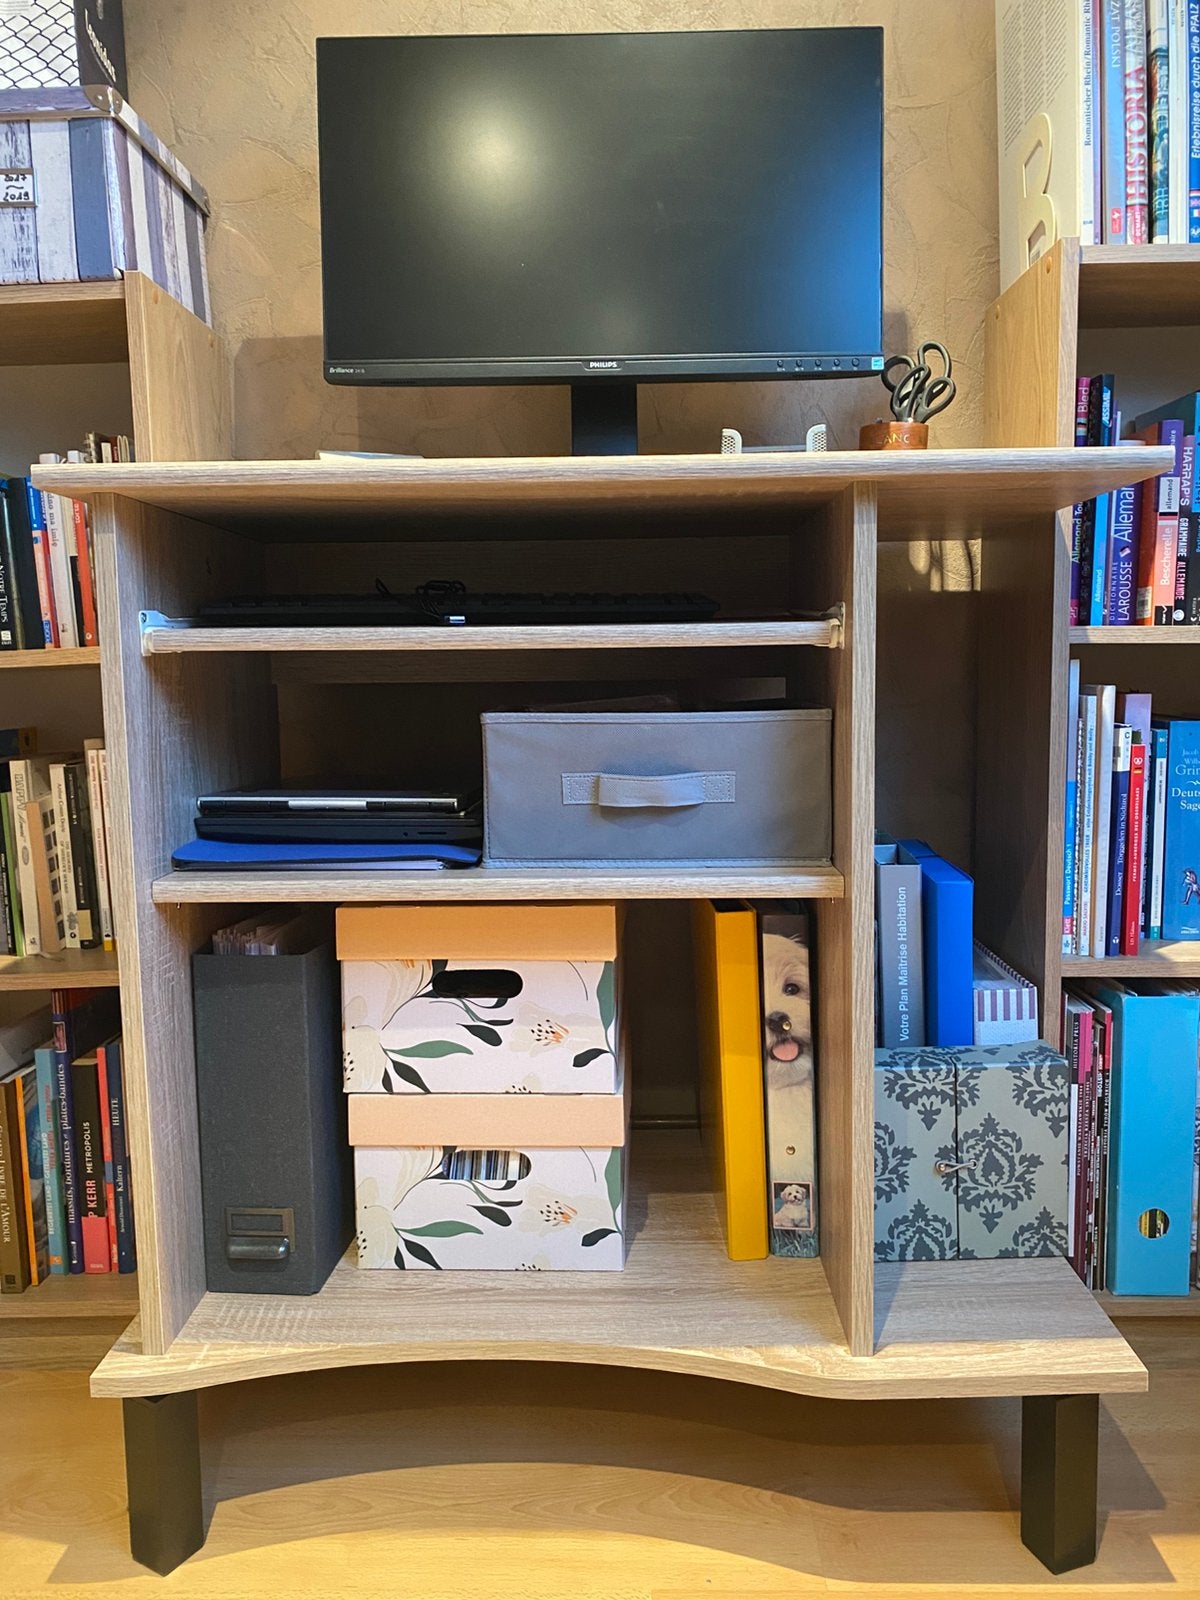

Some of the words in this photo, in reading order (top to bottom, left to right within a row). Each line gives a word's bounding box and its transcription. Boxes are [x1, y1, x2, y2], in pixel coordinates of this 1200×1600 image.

[1189, 3, 1199, 33] PFALZ
[1111, 26, 1121, 68] POLSKI
[1191, 35, 1200, 53] die
[1191, 56, 1200, 88] durch
[1083, 88, 1093, 147] Romantischer
[1125, 65, 1148, 202] HISTORIA
[1191, 89, 1200, 159] Erlebnisreise
[589, 361, 618, 369] PHILIPS
[1078, 386, 1089, 413] Bled
[1101, 389, 1112, 425] ASSIMIL
[1181, 446, 1193, 506] HARRAP'S
[1165, 478, 1174, 511] allemand
[50, 512, 56, 526] ma
[1072, 518, 1084, 564] Allemand
[1178, 517, 1190, 558] GRAMMAIRE
[1159, 527, 1173, 586] Bescherelle
[1094, 569, 1103, 603] Allemand
[1110, 562, 1119, 621] DICTIONNAIRE
[1117, 562, 1133, 621] LAROUSSE
[1174, 561, 1187, 602] ALLEMANDE
[0, 596, 9, 623] TEMPS
[1065, 849, 1073, 874] Deutsch
[1116, 830, 1126, 865] Torggelen
[1063, 874, 1072, 905] Passwort
[895, 886, 908, 942] Habitation
[1063, 918, 1071, 934] Klett
[896, 943, 909, 986] Maîtrise
[898, 988, 909, 1012] Plan
[898, 1014, 910, 1042] Votre
[56, 1062, 73, 1131] plates-bandes
[110, 1097, 121, 1126] HEUTE
[61, 1141, 74, 1186] bordures
[82, 1121, 95, 1174] METROPOLIS
[0, 1188, 7, 1201] DE
[85, 1179, 98, 1210] KERR
[115, 1164, 125, 1192] Kaltern
[1, 1203, 11, 1244] L'AMOUR
